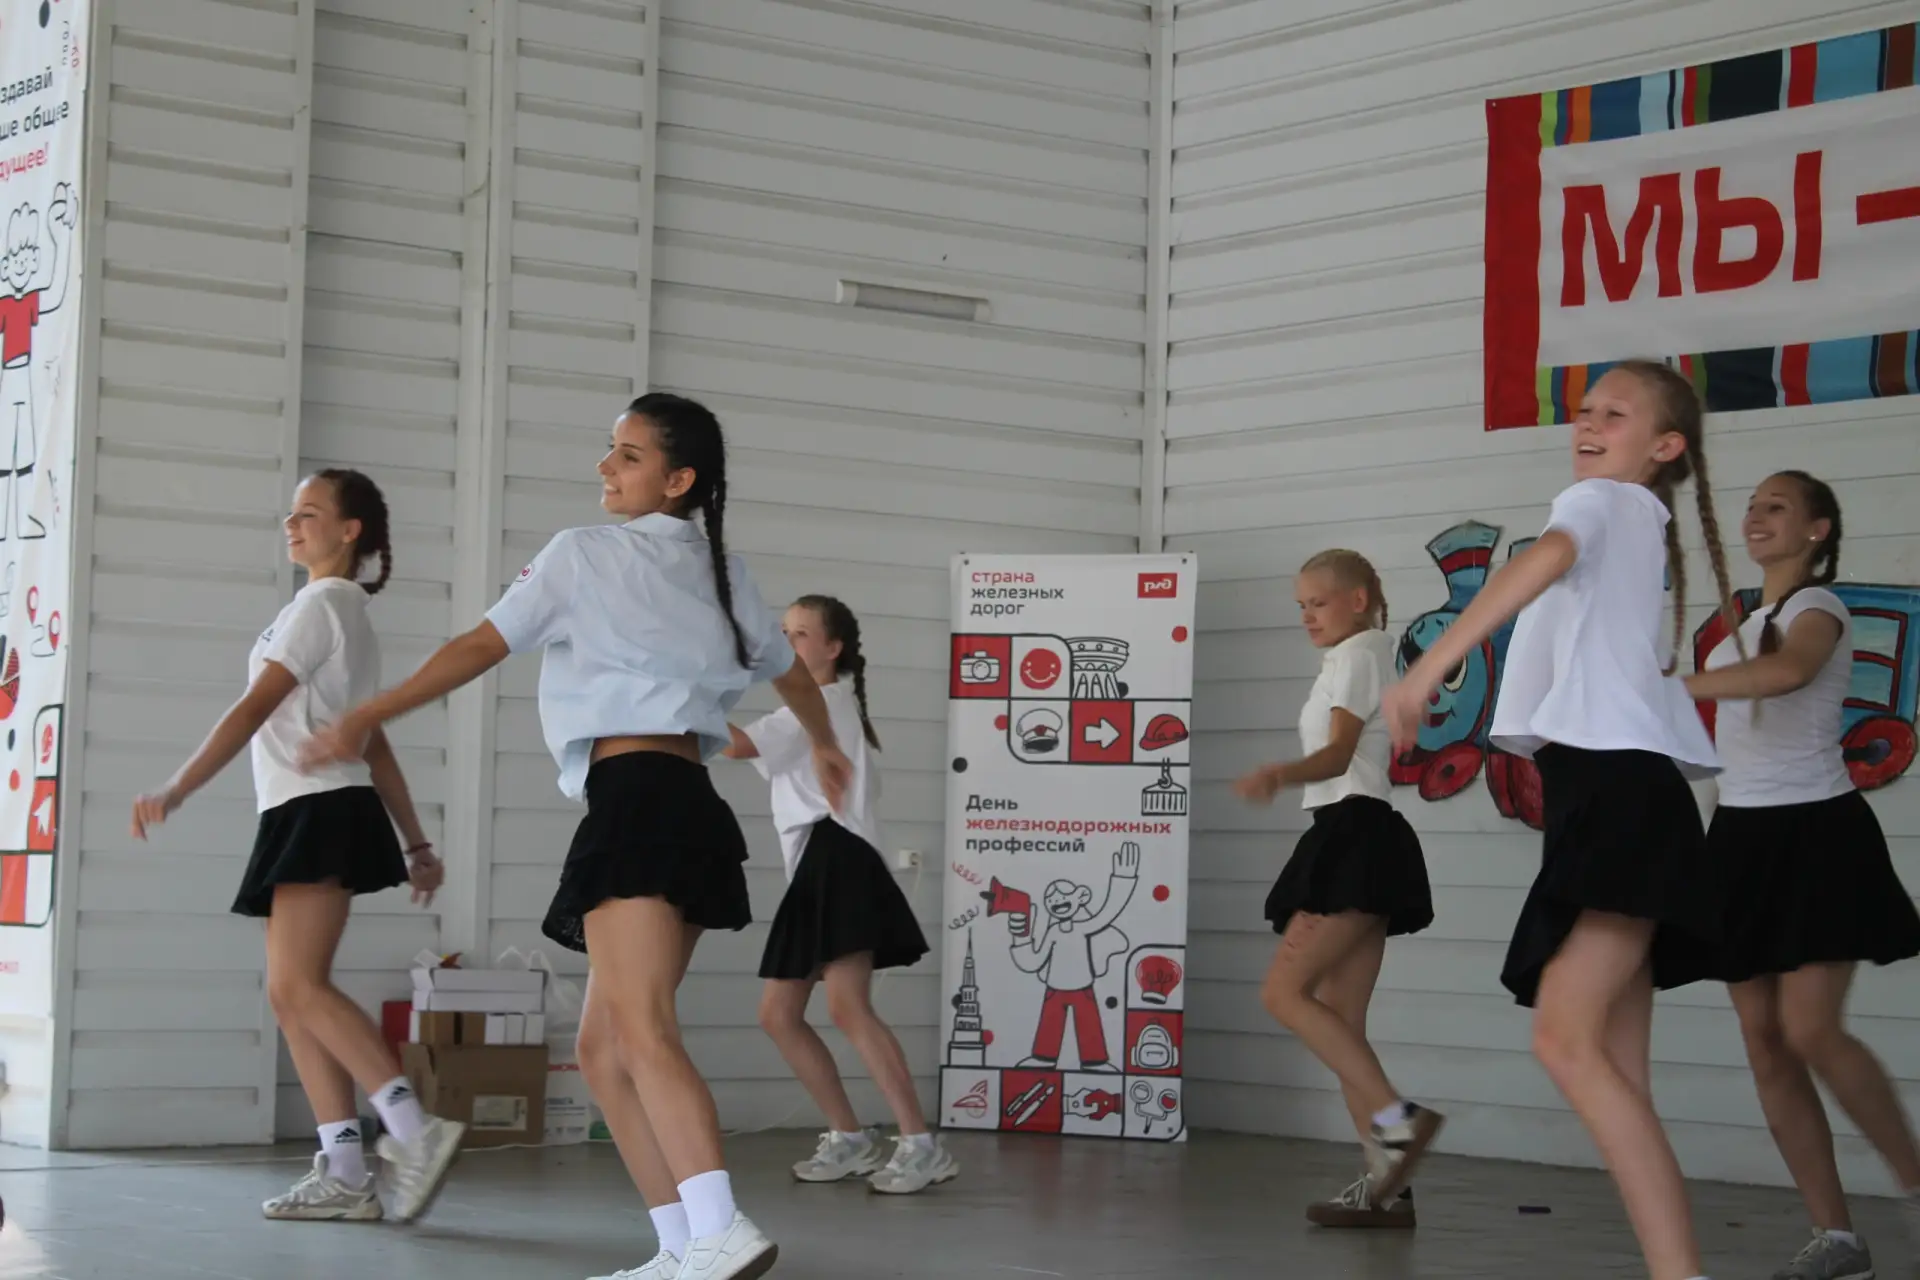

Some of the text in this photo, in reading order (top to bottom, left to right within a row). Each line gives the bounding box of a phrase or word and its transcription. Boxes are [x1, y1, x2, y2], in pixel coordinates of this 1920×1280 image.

[1560, 149, 1823, 308] МЫ
[971, 571, 1035, 586] страна
[971, 586, 1064, 600] железных
[970, 602, 1026, 618] дорог
[965, 794, 1019, 812] День
[965, 817, 1172, 836] железнодорожных
[965, 836, 1086, 855] профессий
